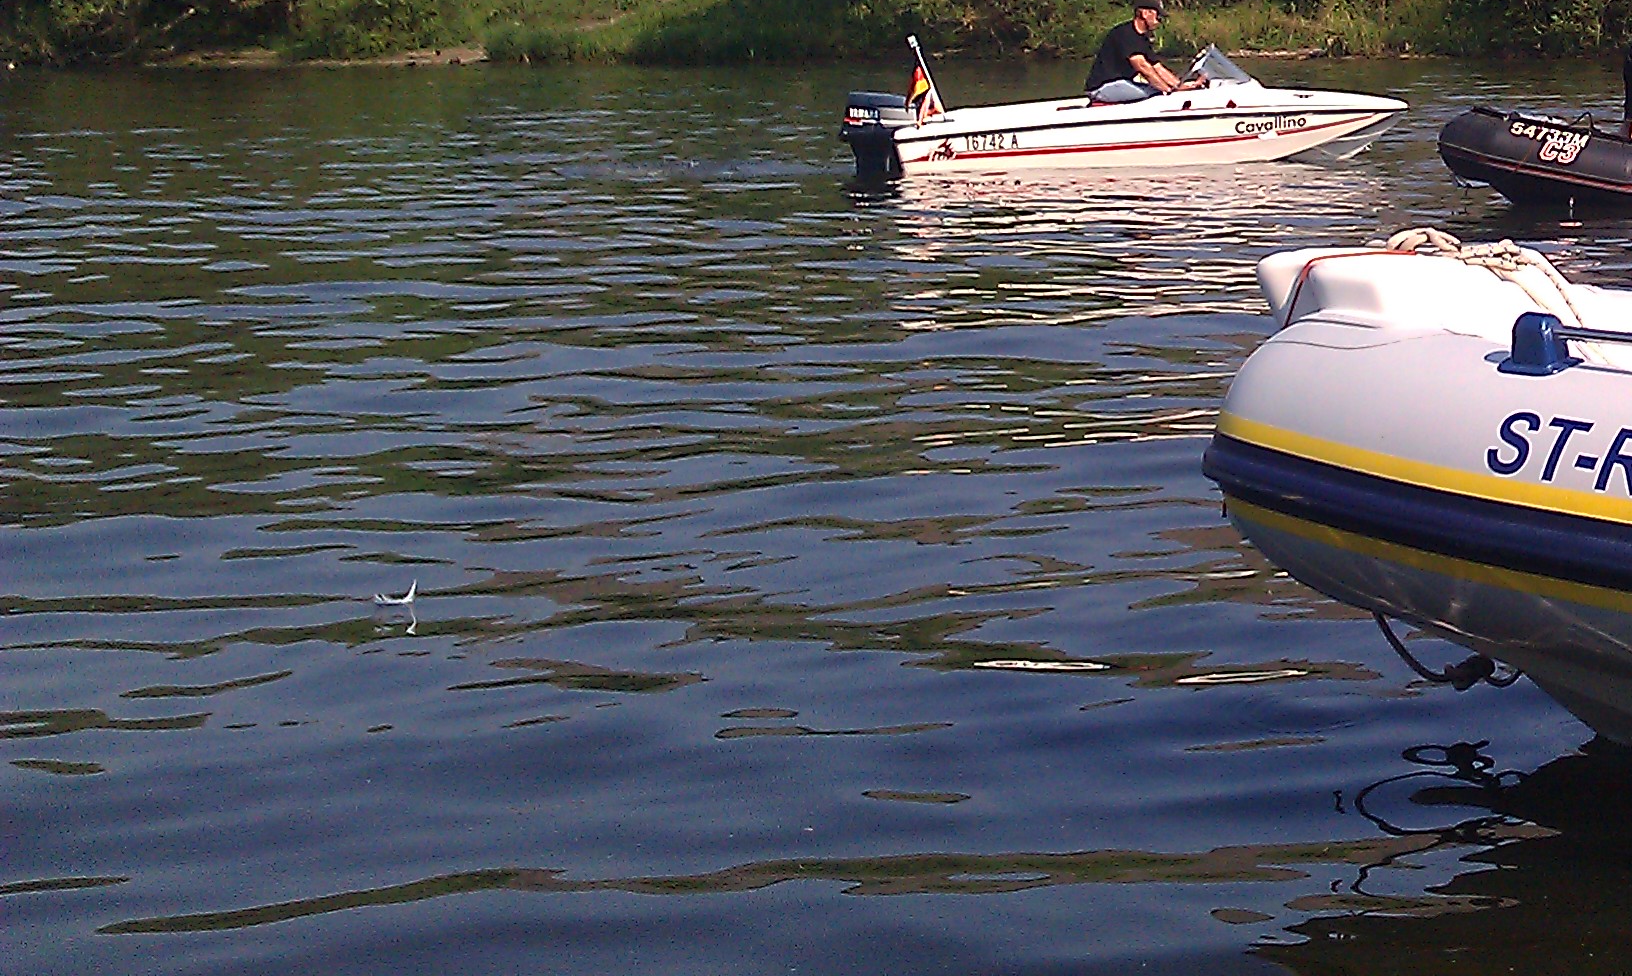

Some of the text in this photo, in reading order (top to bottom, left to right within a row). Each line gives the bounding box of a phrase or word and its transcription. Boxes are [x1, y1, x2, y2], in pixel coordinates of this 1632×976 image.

[1235, 116, 1307, 134] Cavallino
[964, 131, 1019, 151] 16742 A
[1539, 140, 1581, 164] C3
